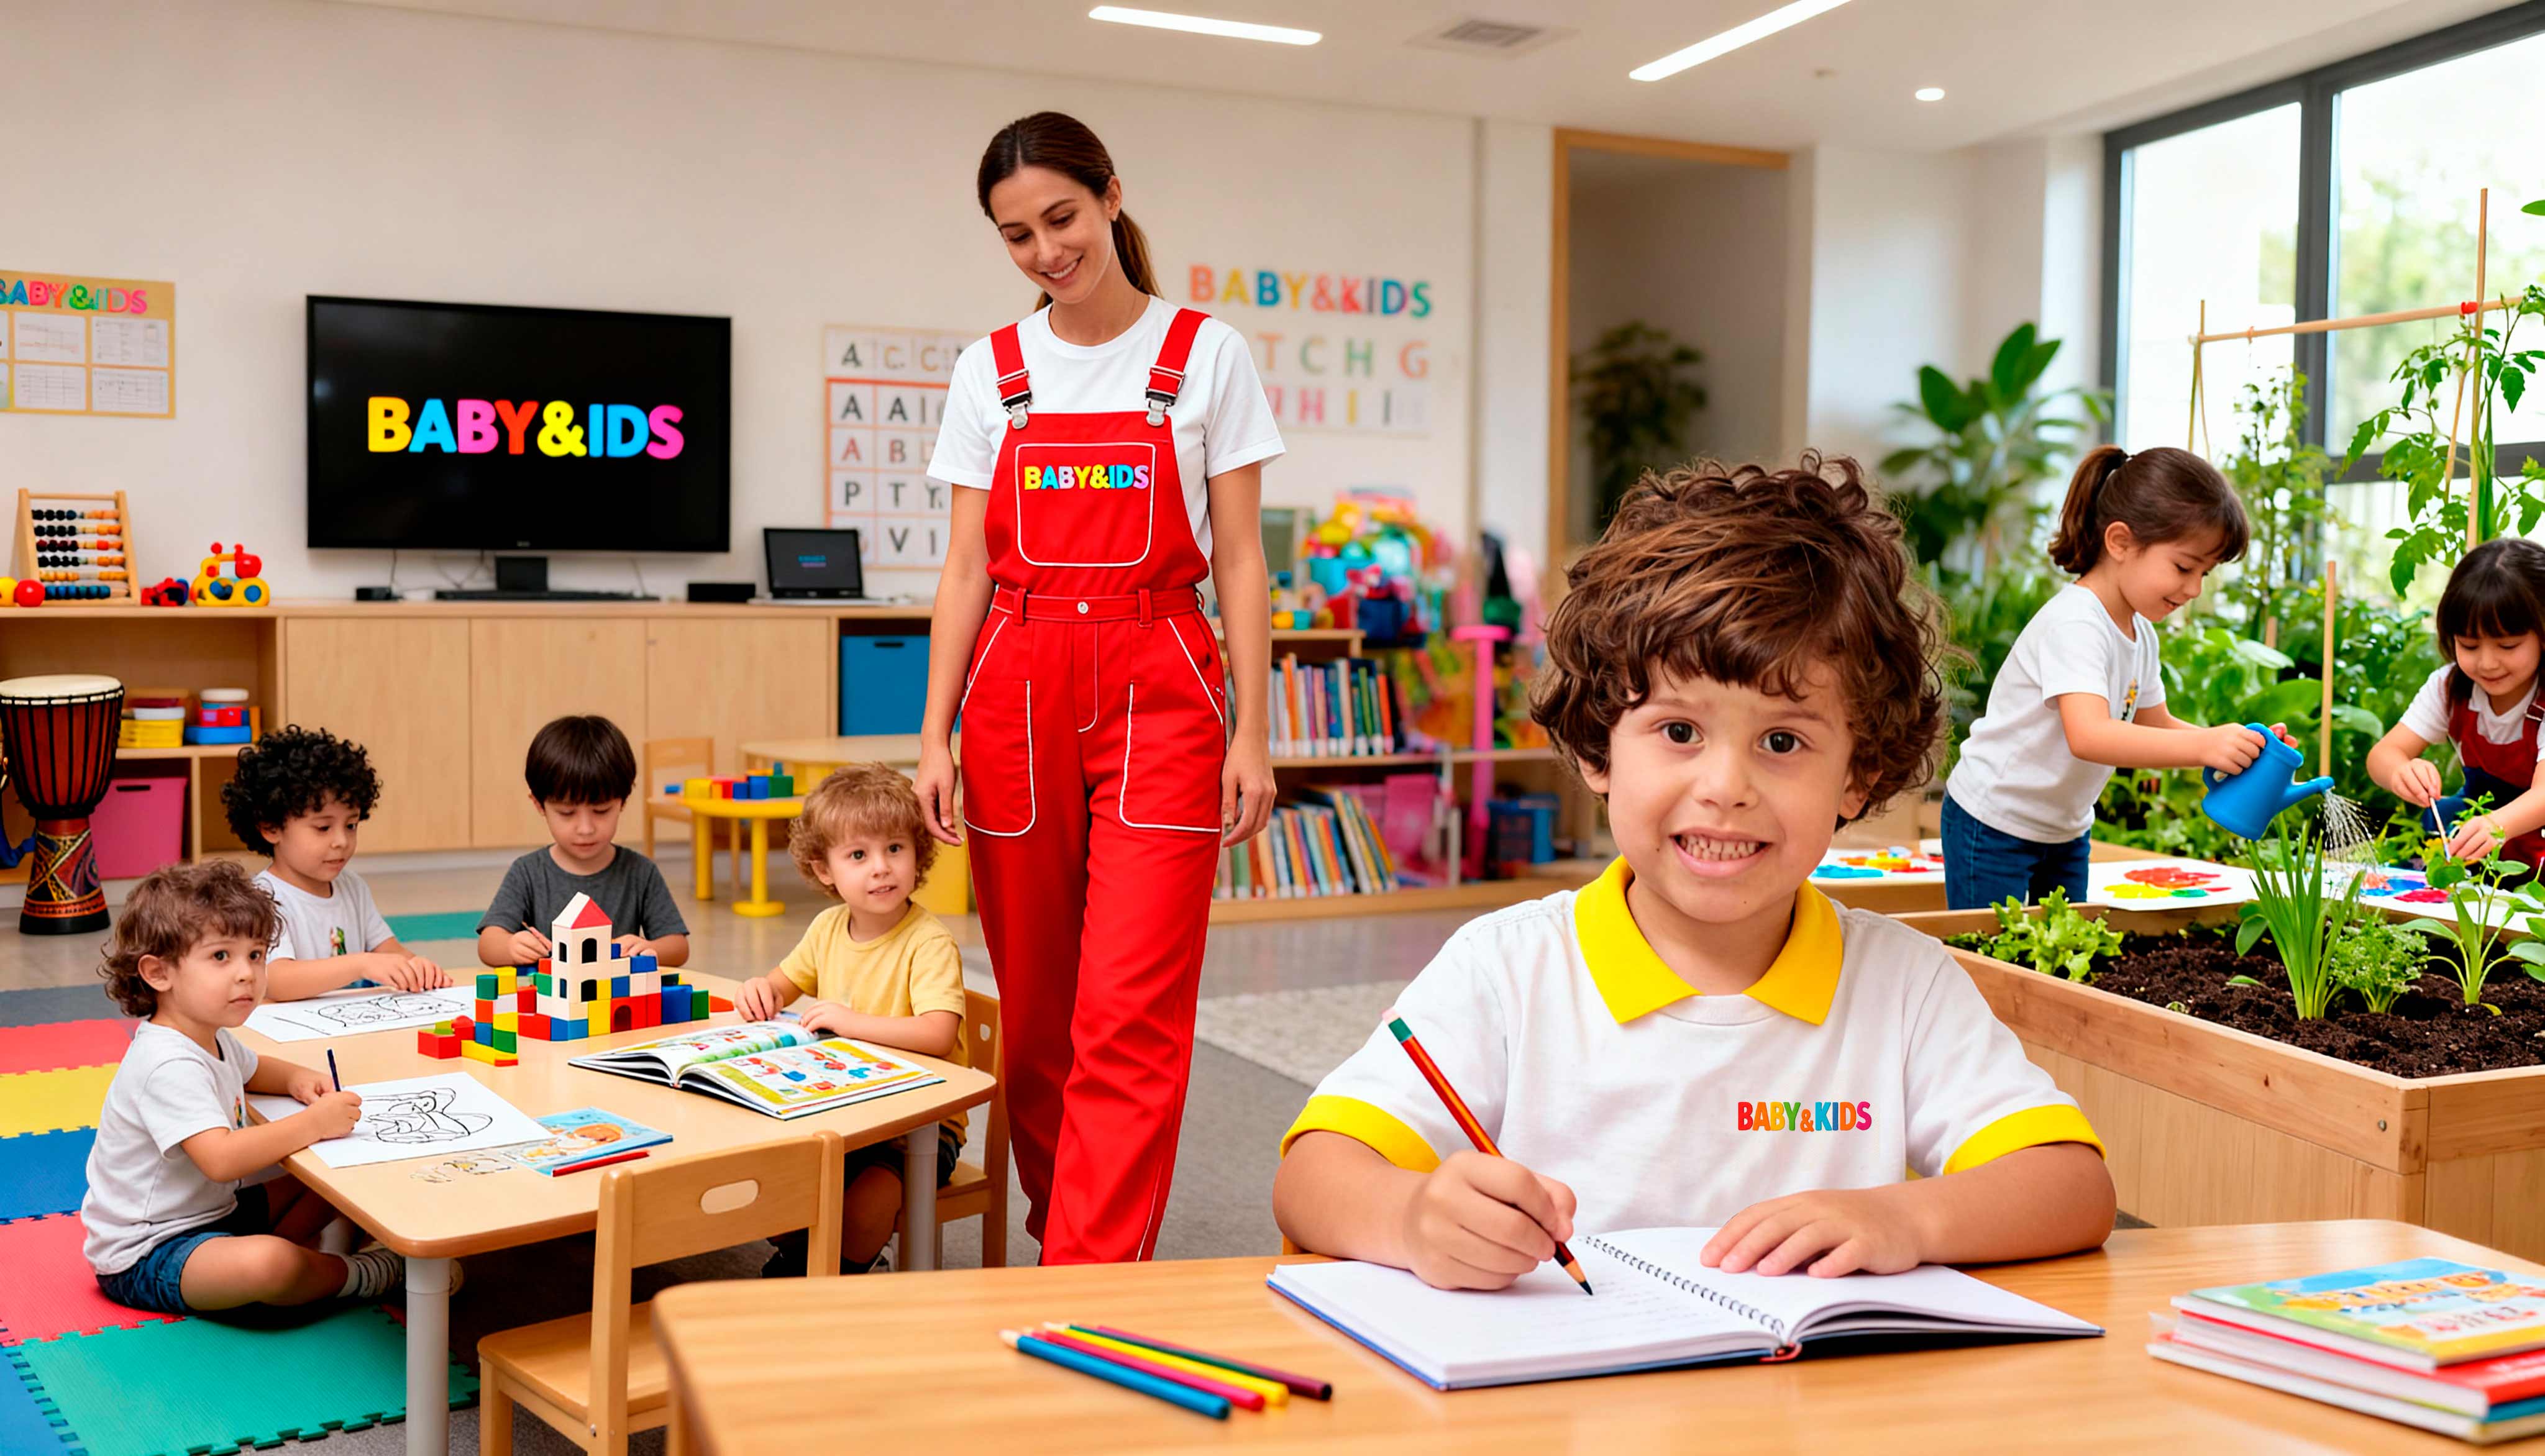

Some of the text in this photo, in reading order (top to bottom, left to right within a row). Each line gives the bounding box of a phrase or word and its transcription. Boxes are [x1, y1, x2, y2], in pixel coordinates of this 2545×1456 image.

[1189, 265, 1432, 318] BABY&KIDS
[367, 396, 685, 460] BABY&IDS
[1024, 464, 1149, 490] BABY&IDS
[1738, 1101, 1872, 1132] BABY&KIDS
